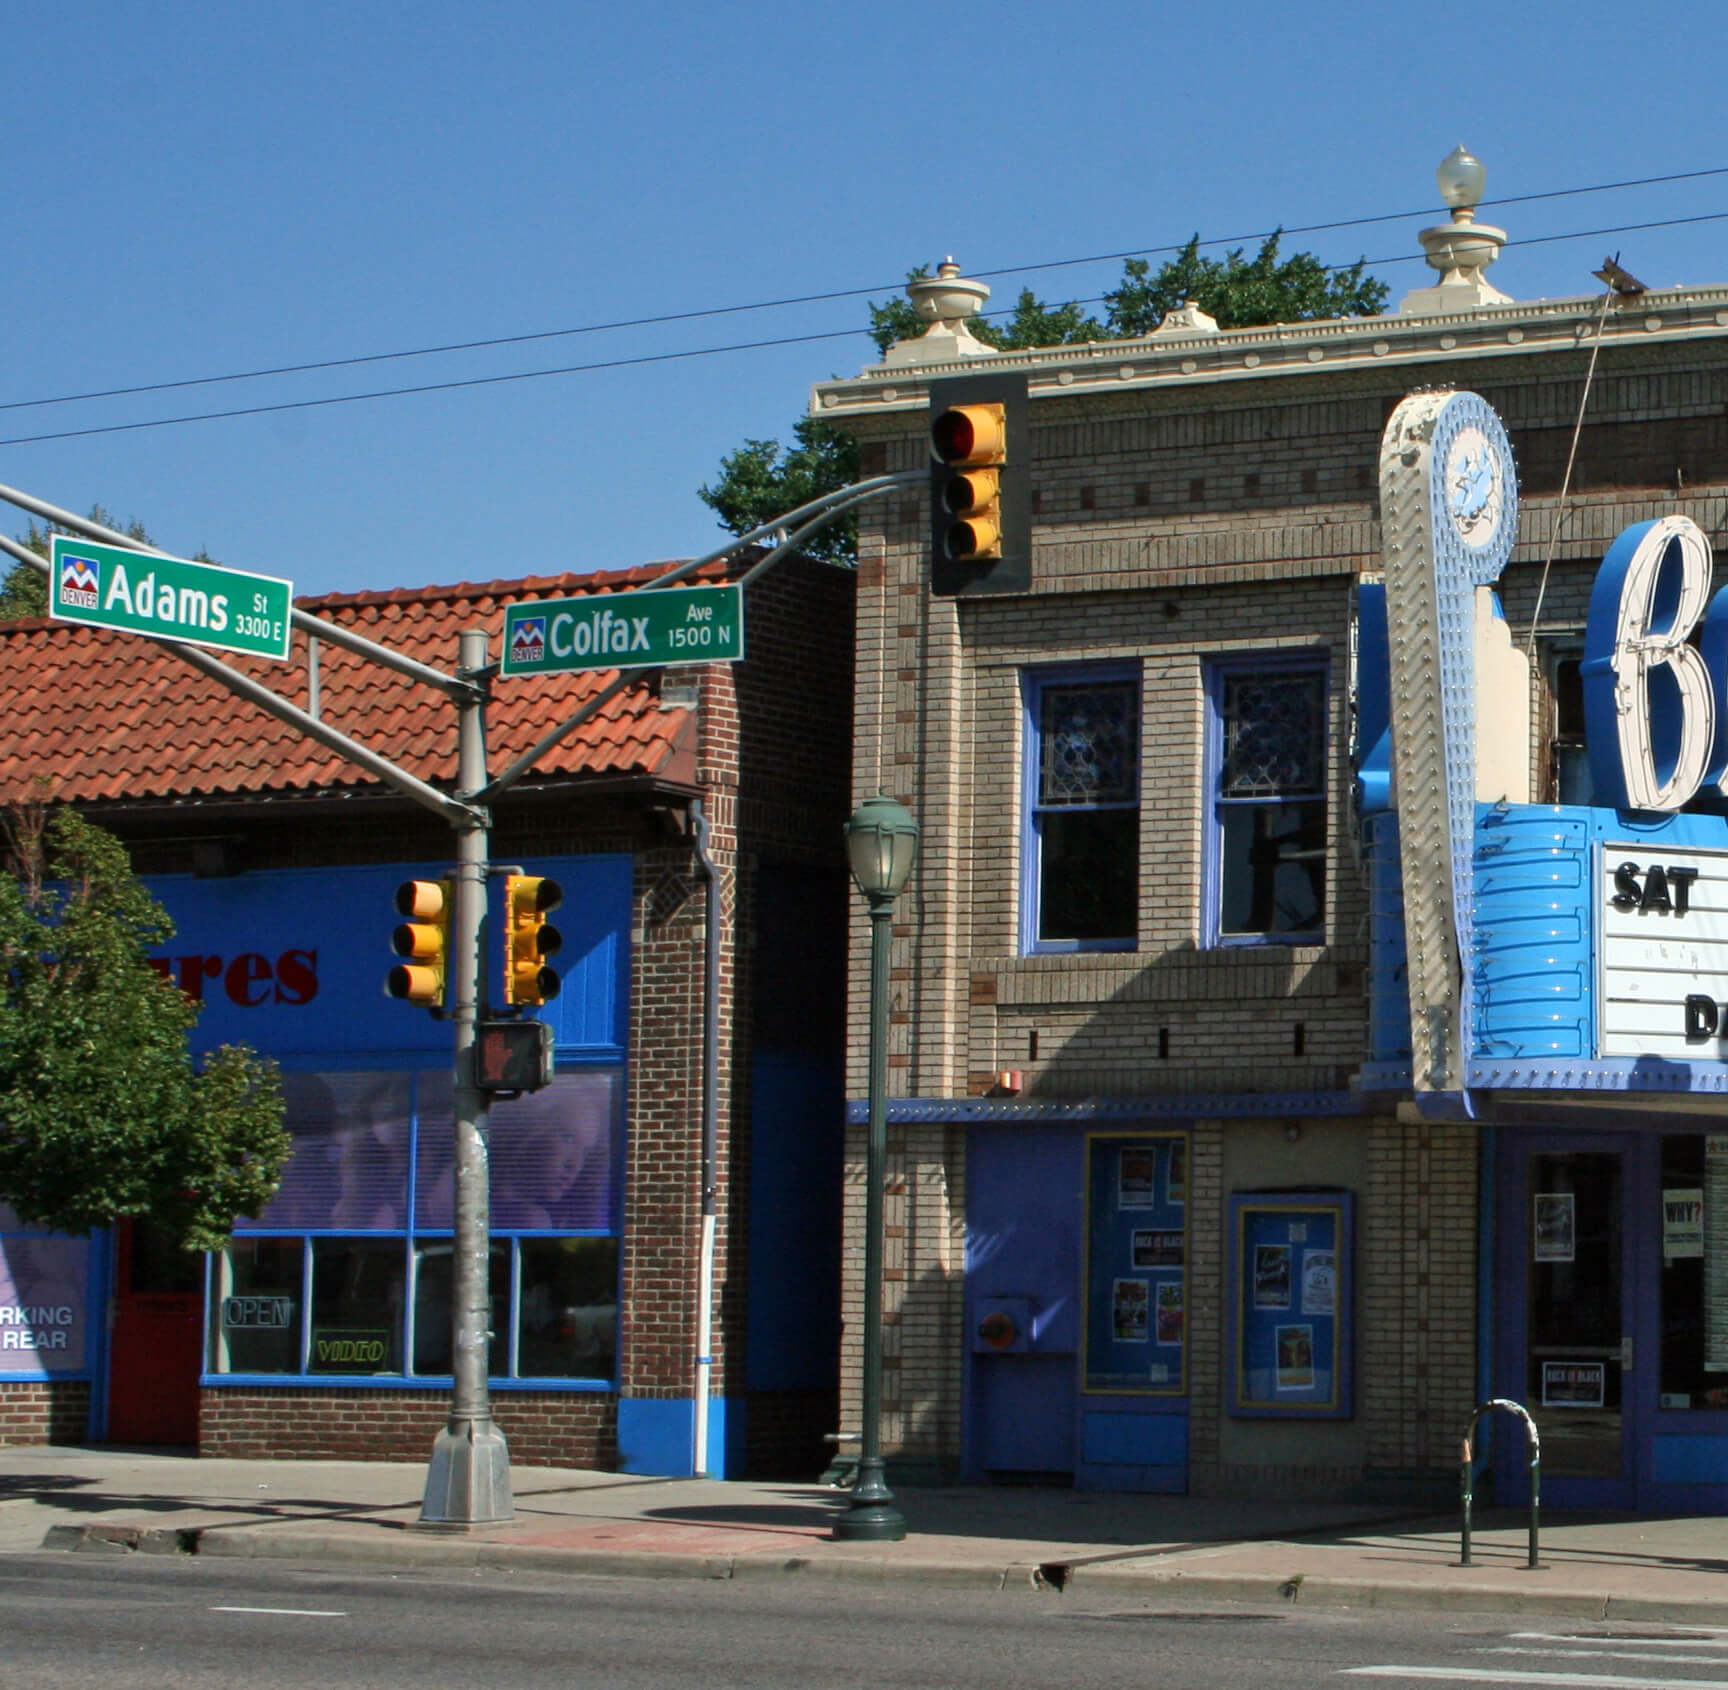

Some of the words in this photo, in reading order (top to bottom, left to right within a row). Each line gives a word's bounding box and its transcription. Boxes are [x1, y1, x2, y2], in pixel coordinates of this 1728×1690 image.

[61, 588, 98, 609] DENVER
[104, 564, 228, 632] Adams
[253, 592, 268, 614] St
[686, 603, 713, 622] Ave
[235, 614, 271, 639] 3300
[272, 621, 283, 642] E
[550, 609, 651, 658] Colfax
[668, 627, 712, 648] 1500
[718, 625, 731, 645] N
[511, 646, 544, 662] DENVER
[1613, 861, 1699, 915] SAT
[1665, 1201, 1702, 1223] WHY?
[226, 1299, 288, 1326] OPEN
[3, 1330, 67, 1349] REAR
[317, 1340, 385, 1362] VIDEO
